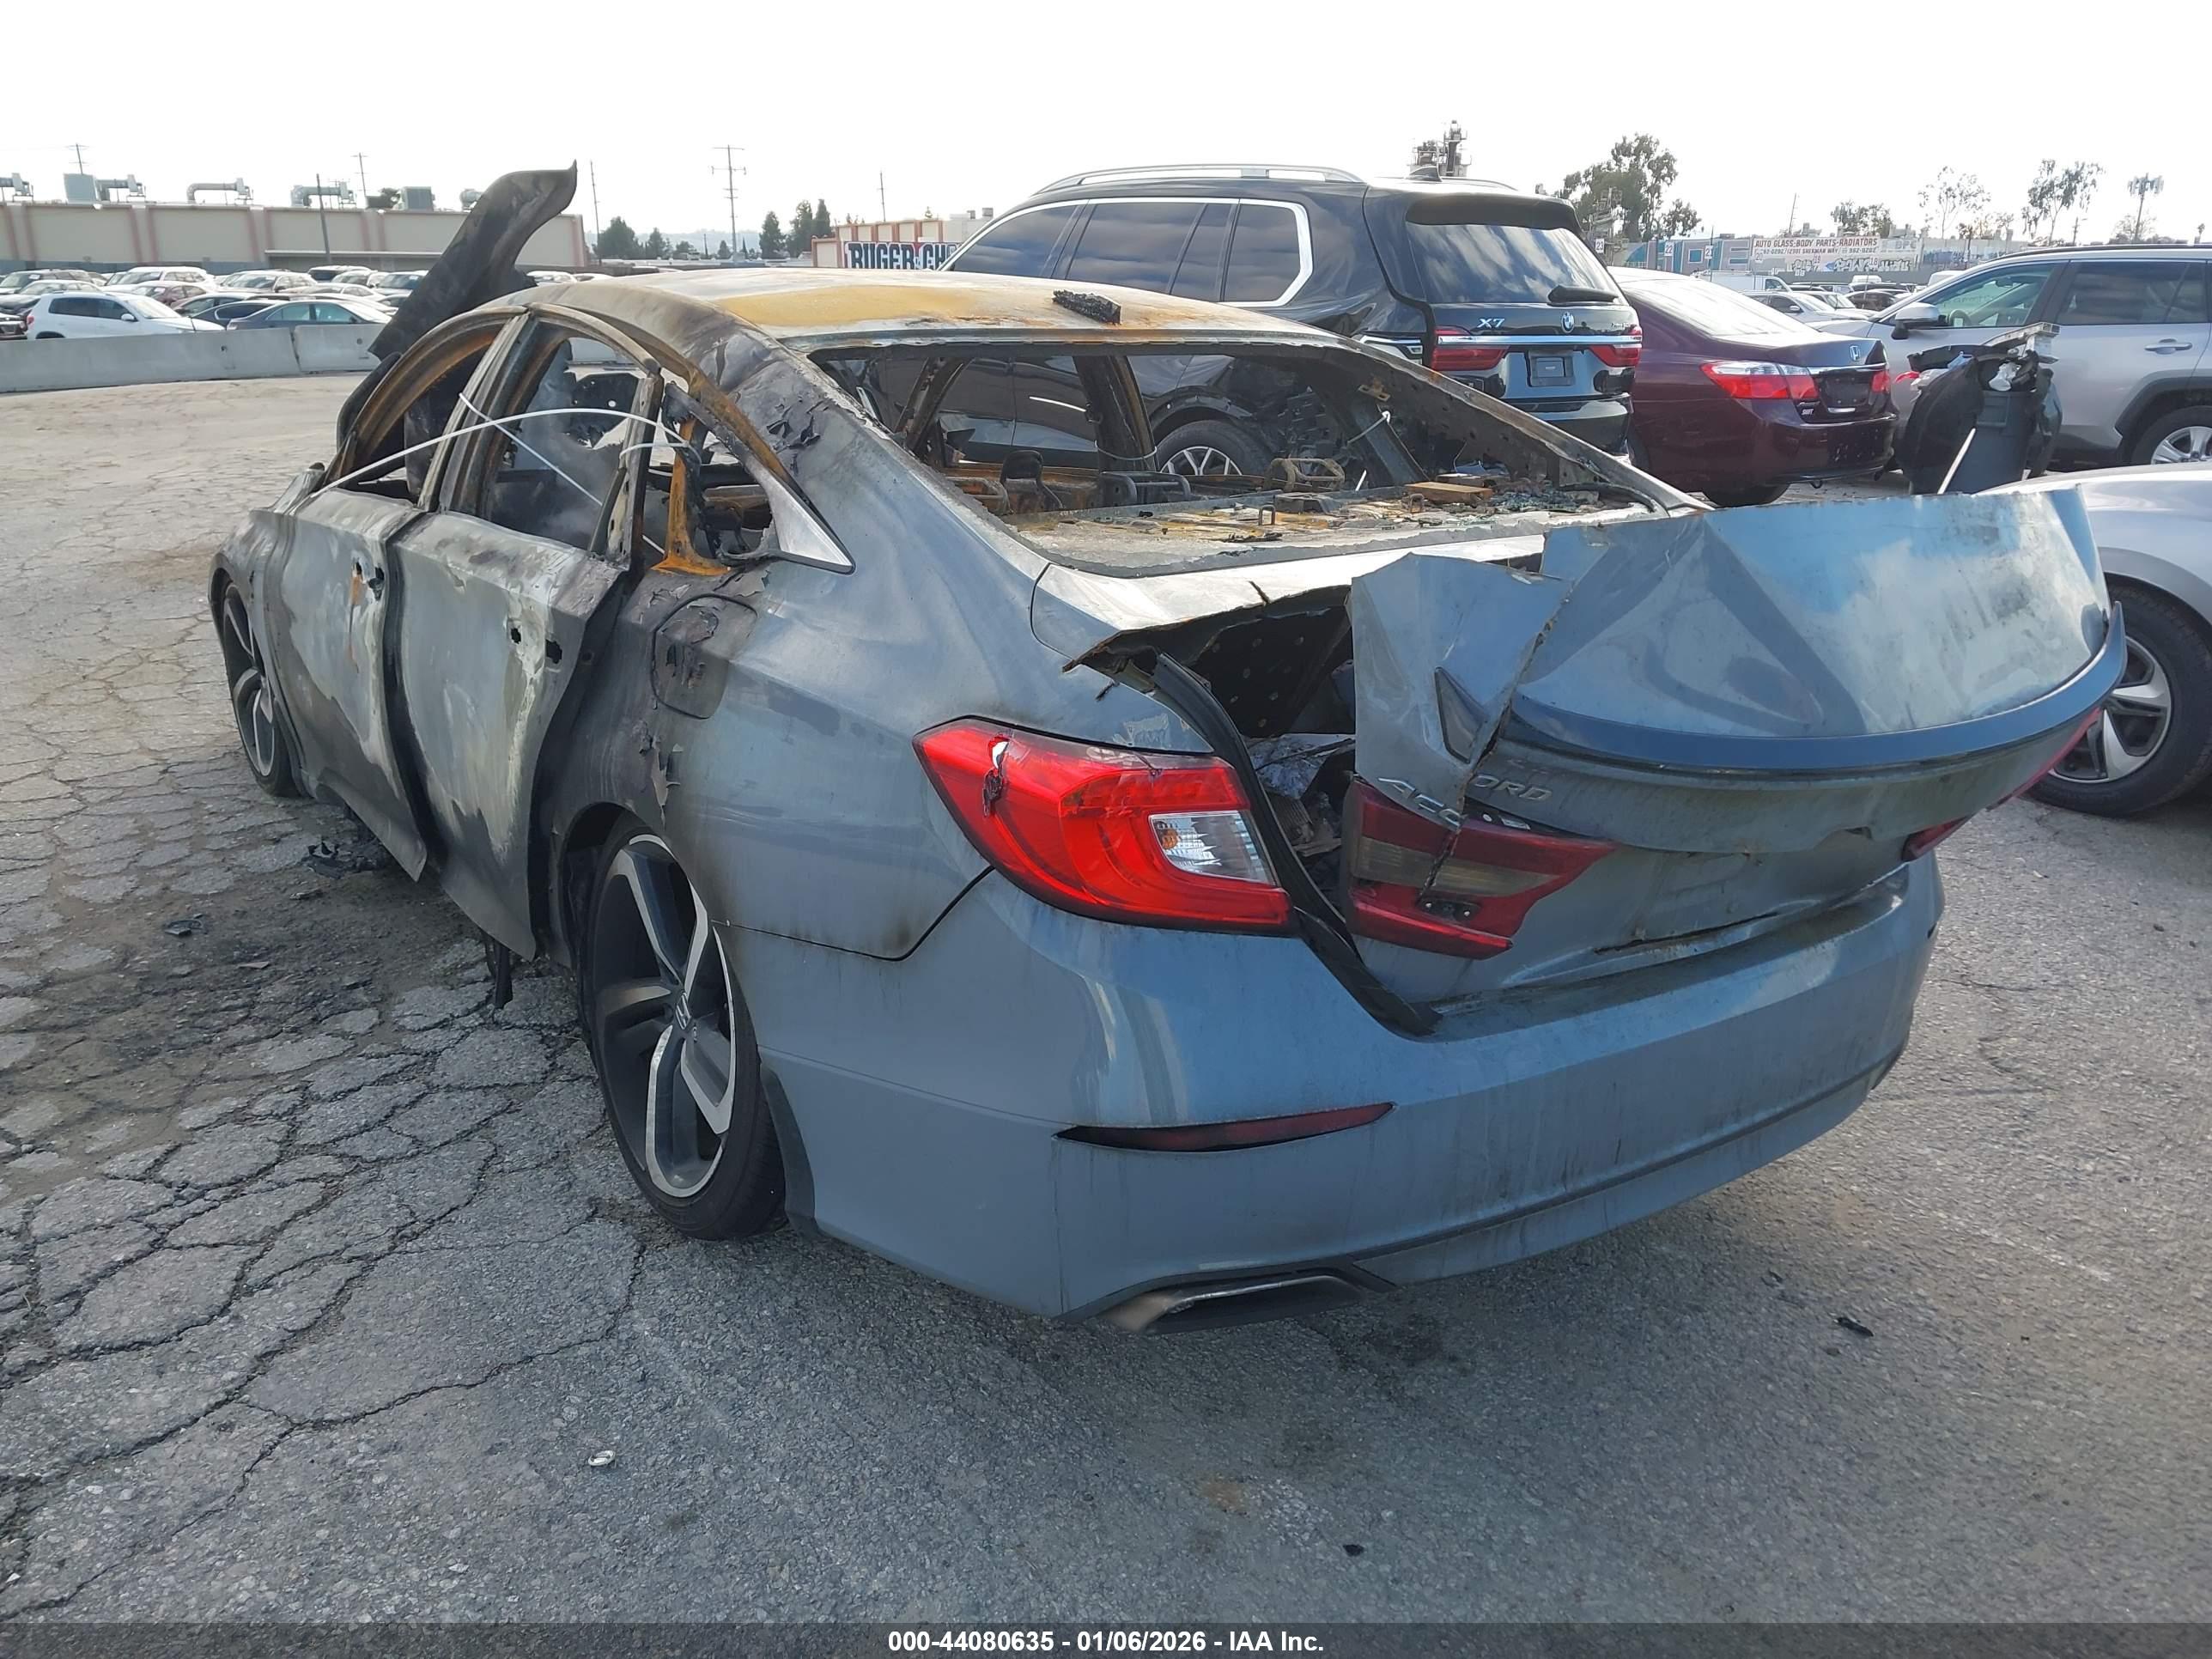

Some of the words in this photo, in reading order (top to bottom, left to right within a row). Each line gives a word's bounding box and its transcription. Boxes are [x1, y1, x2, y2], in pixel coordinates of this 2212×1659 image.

[1595, 240, 1604, 252] 23
[1815, 237, 1878, 247] PARTS-RADIATORS
[1665, 245, 1674, 255] 22
[1476, 317, 1505, 329] X7
